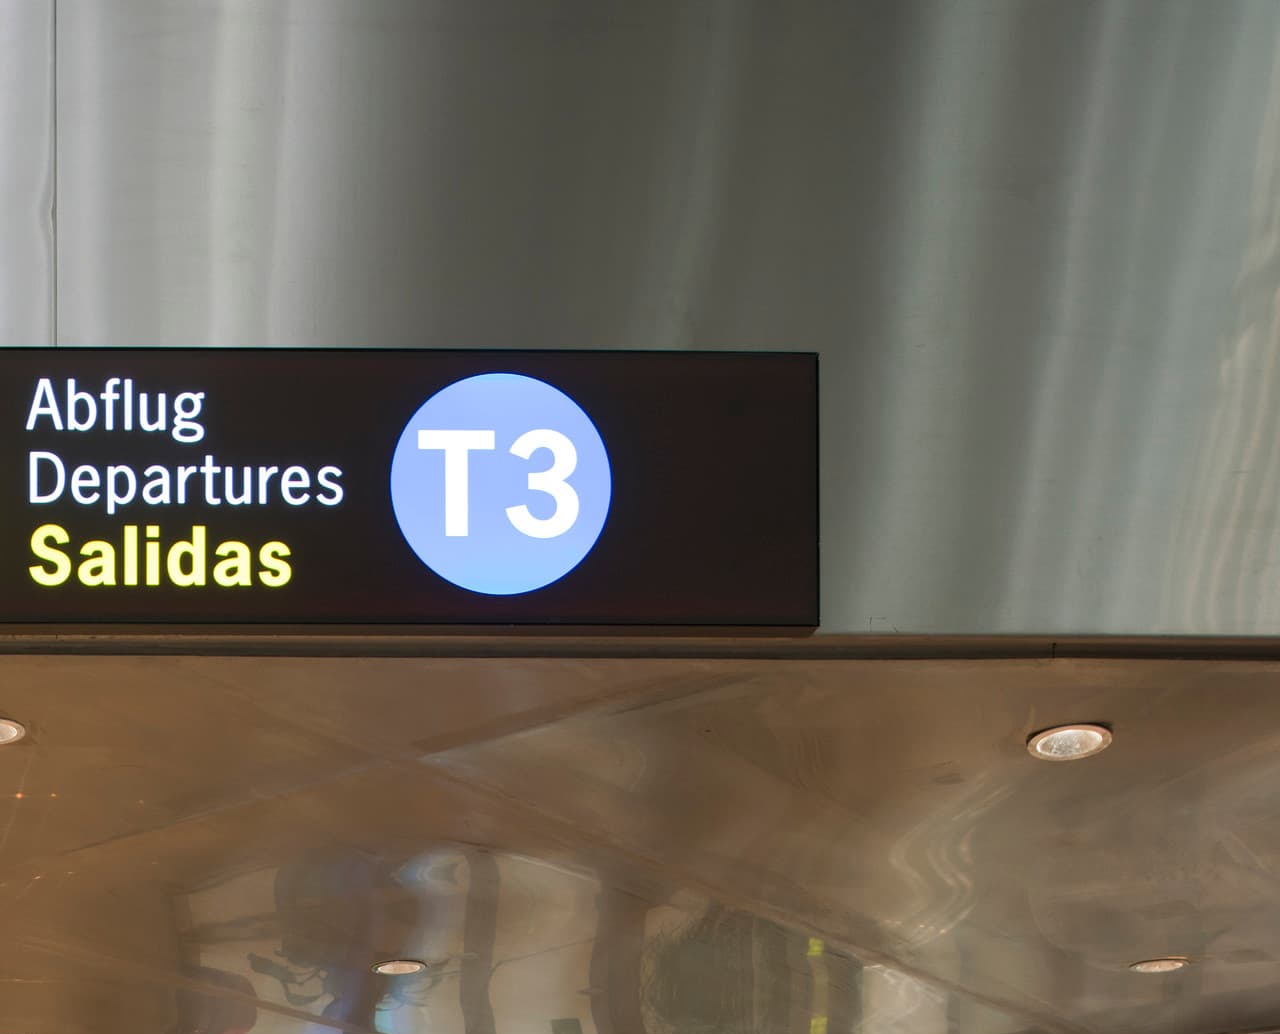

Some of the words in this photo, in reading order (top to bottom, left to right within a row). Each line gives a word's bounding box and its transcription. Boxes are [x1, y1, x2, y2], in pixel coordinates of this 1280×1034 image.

[25, 377, 206, 443] Abflug
[28, 450, 345, 515] Departures
[417, 428, 580, 539] T3
[28, 523, 293, 587] Salidas
